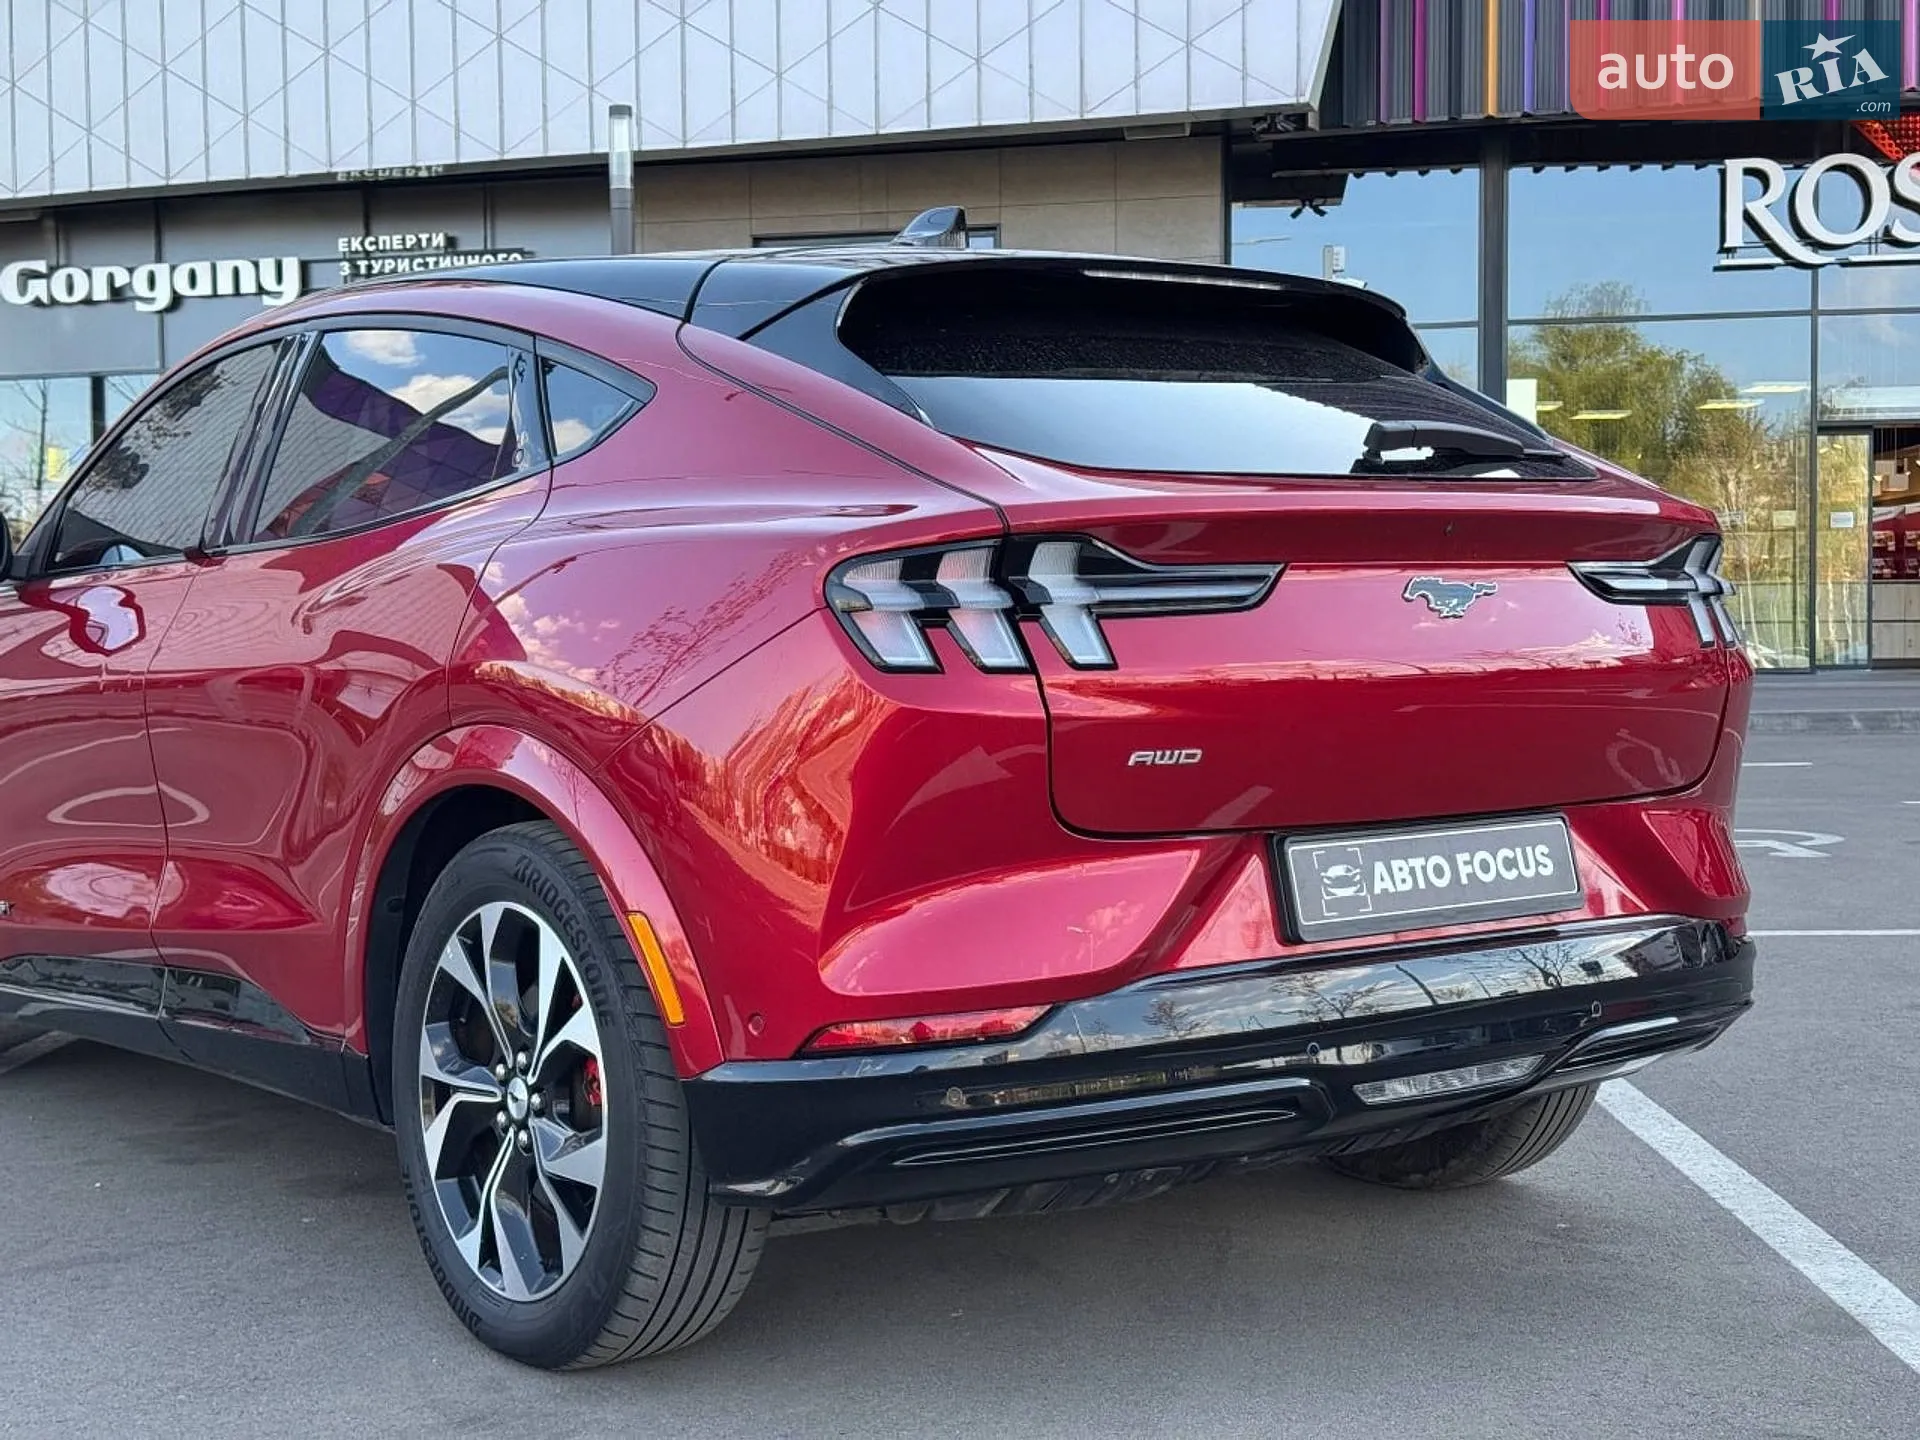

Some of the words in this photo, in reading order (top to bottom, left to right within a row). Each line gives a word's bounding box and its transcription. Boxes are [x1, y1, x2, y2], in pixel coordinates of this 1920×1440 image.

[338, 232, 445, 252] ЕКСПЕРТИ
[0, 256, 300, 313] Gorgany
[1127, 748, 1203, 766] AWD
[1456, 844, 1554, 886] FOCUS
